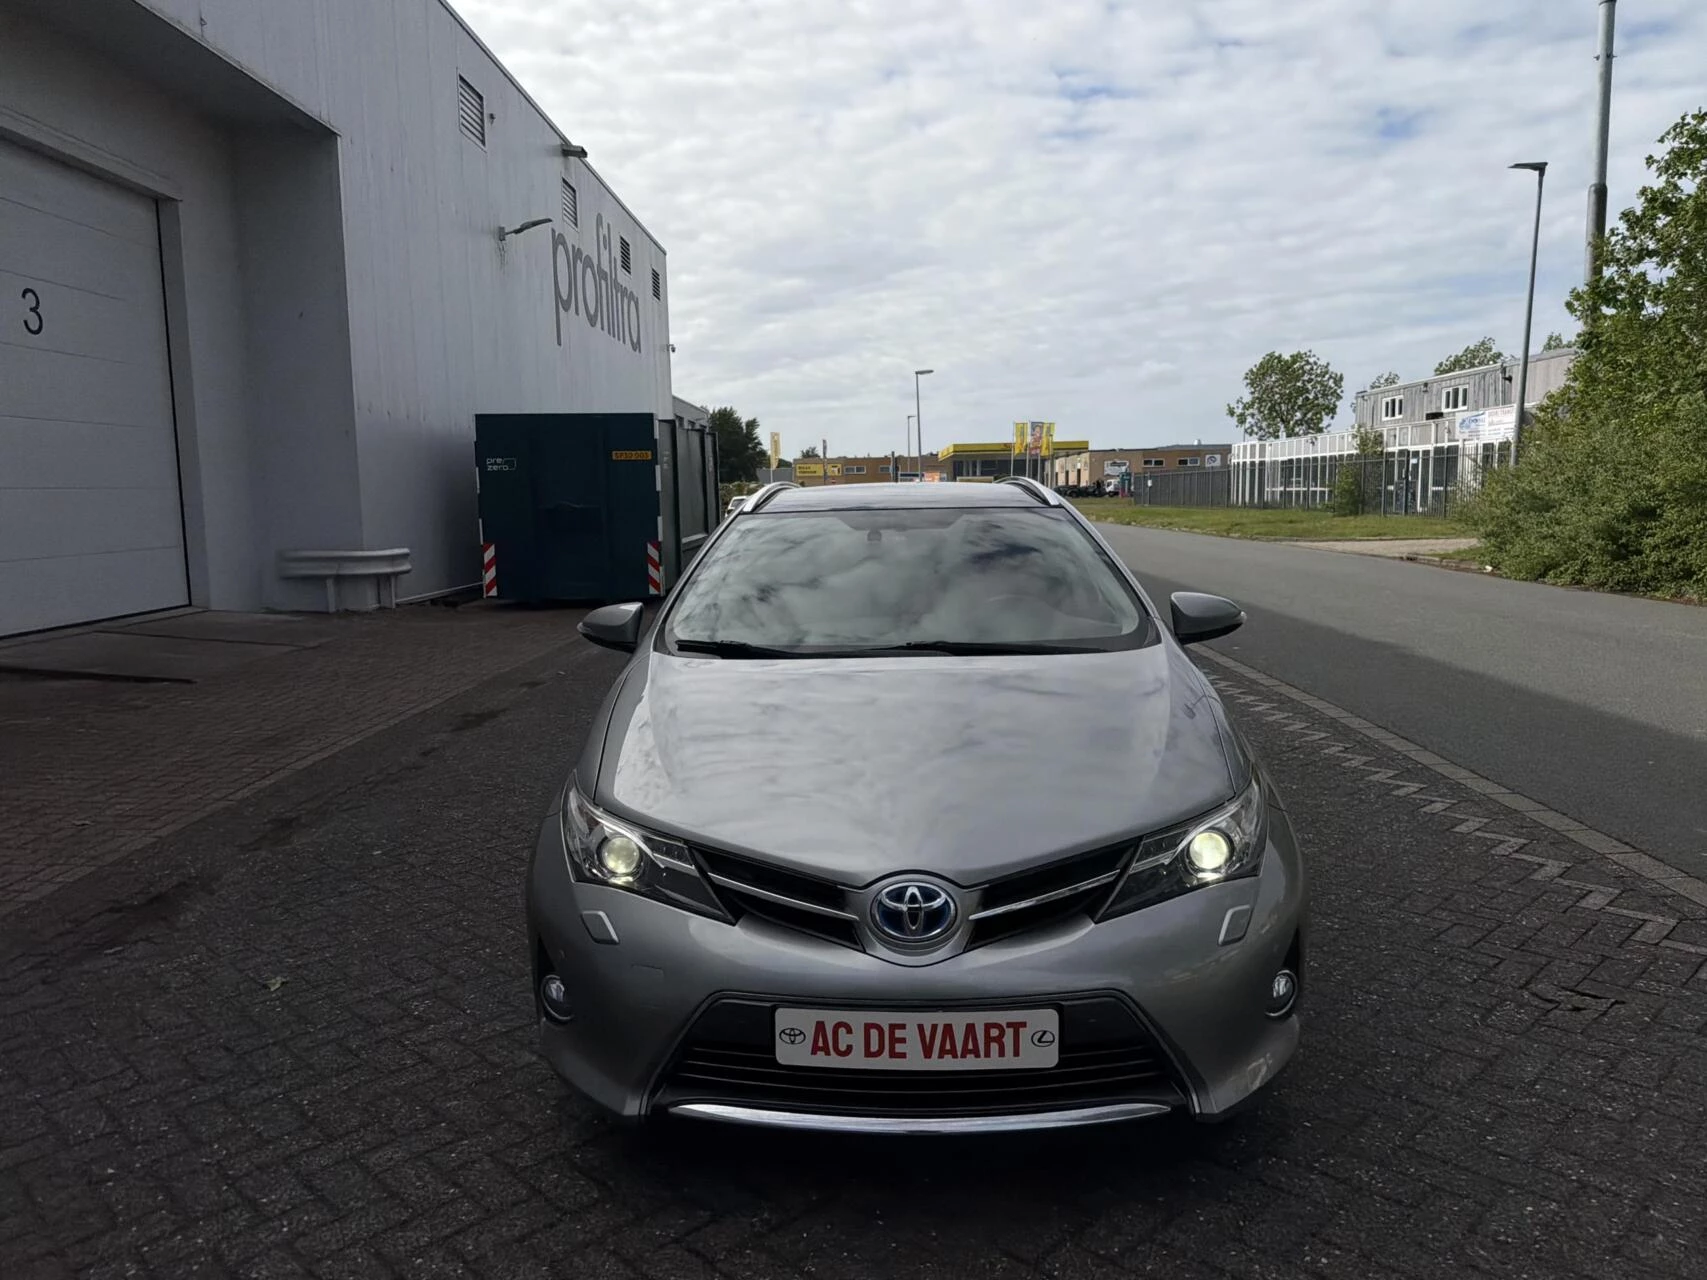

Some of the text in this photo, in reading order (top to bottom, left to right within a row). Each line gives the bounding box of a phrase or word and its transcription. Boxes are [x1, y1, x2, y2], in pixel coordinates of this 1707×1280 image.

[552, 213, 641, 353] profiltra
[22, 288, 43, 334] 3
[810, 1020, 853, 1058] AC
[863, 1023, 907, 1059] DE
[916, 1021, 1027, 1060] VAART
